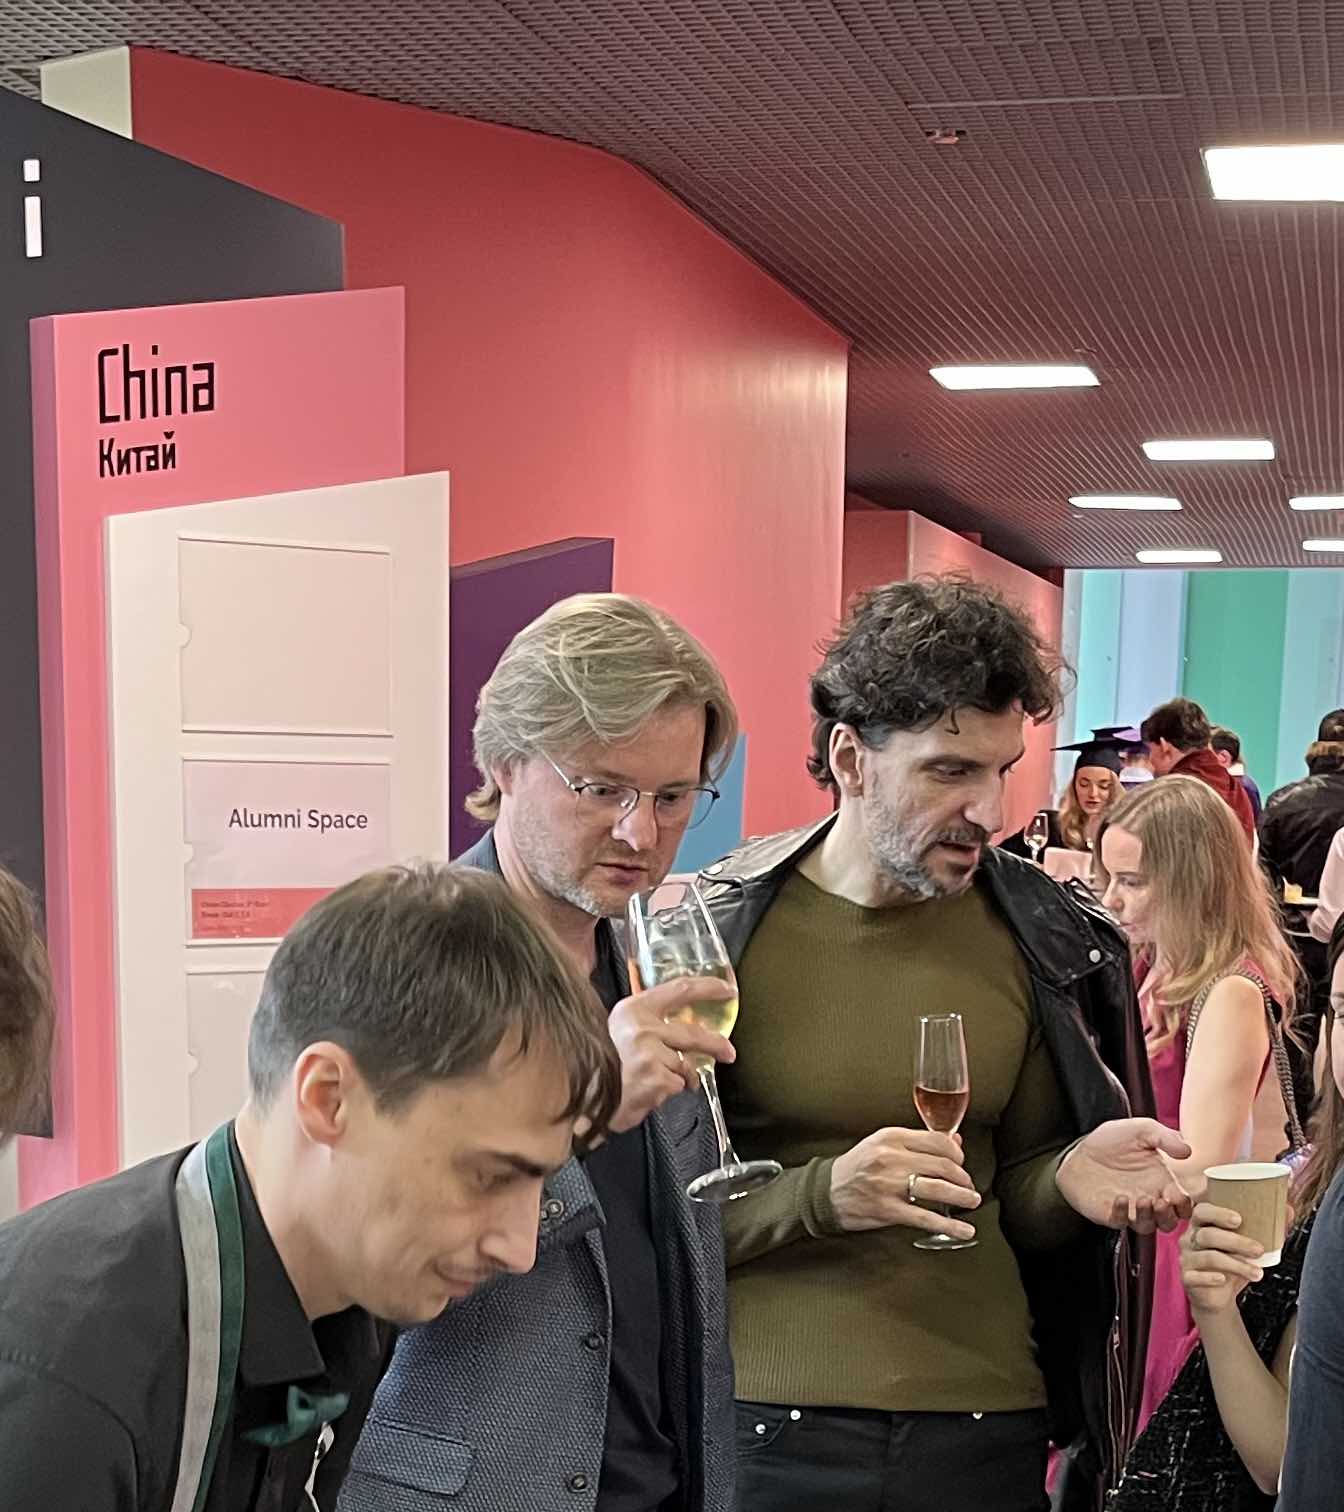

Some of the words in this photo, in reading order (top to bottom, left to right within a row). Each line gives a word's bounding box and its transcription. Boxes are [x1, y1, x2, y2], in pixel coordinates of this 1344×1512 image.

[98, 343, 215, 424] China
[99, 431, 176, 478] Китай
[228, 808, 302, 829] Alumni
[307, 810, 369, 833] Space
